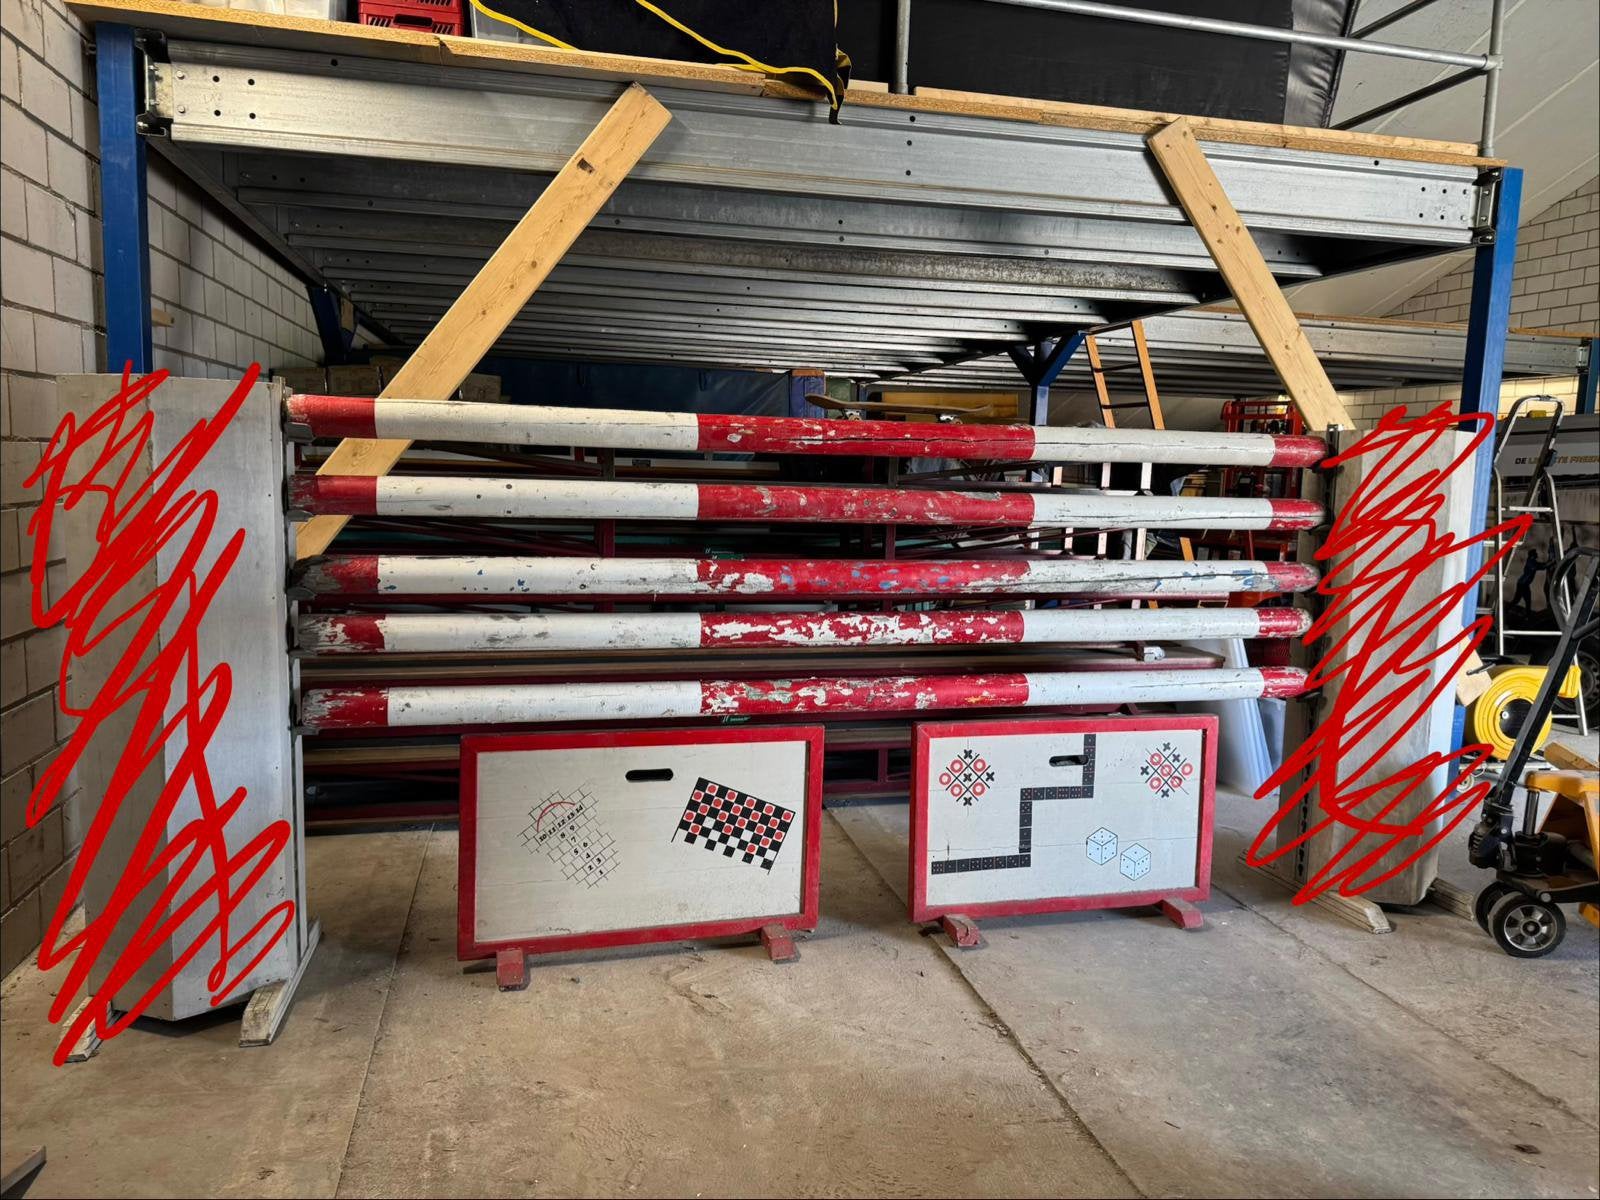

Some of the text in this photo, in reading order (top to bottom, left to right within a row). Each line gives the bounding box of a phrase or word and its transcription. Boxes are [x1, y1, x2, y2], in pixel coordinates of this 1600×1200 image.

[539, 834, 547, 842] 10
[557, 819, 566, 828] 12
[566, 812, 574, 820] 13
[576, 804, 584, 814] 14
